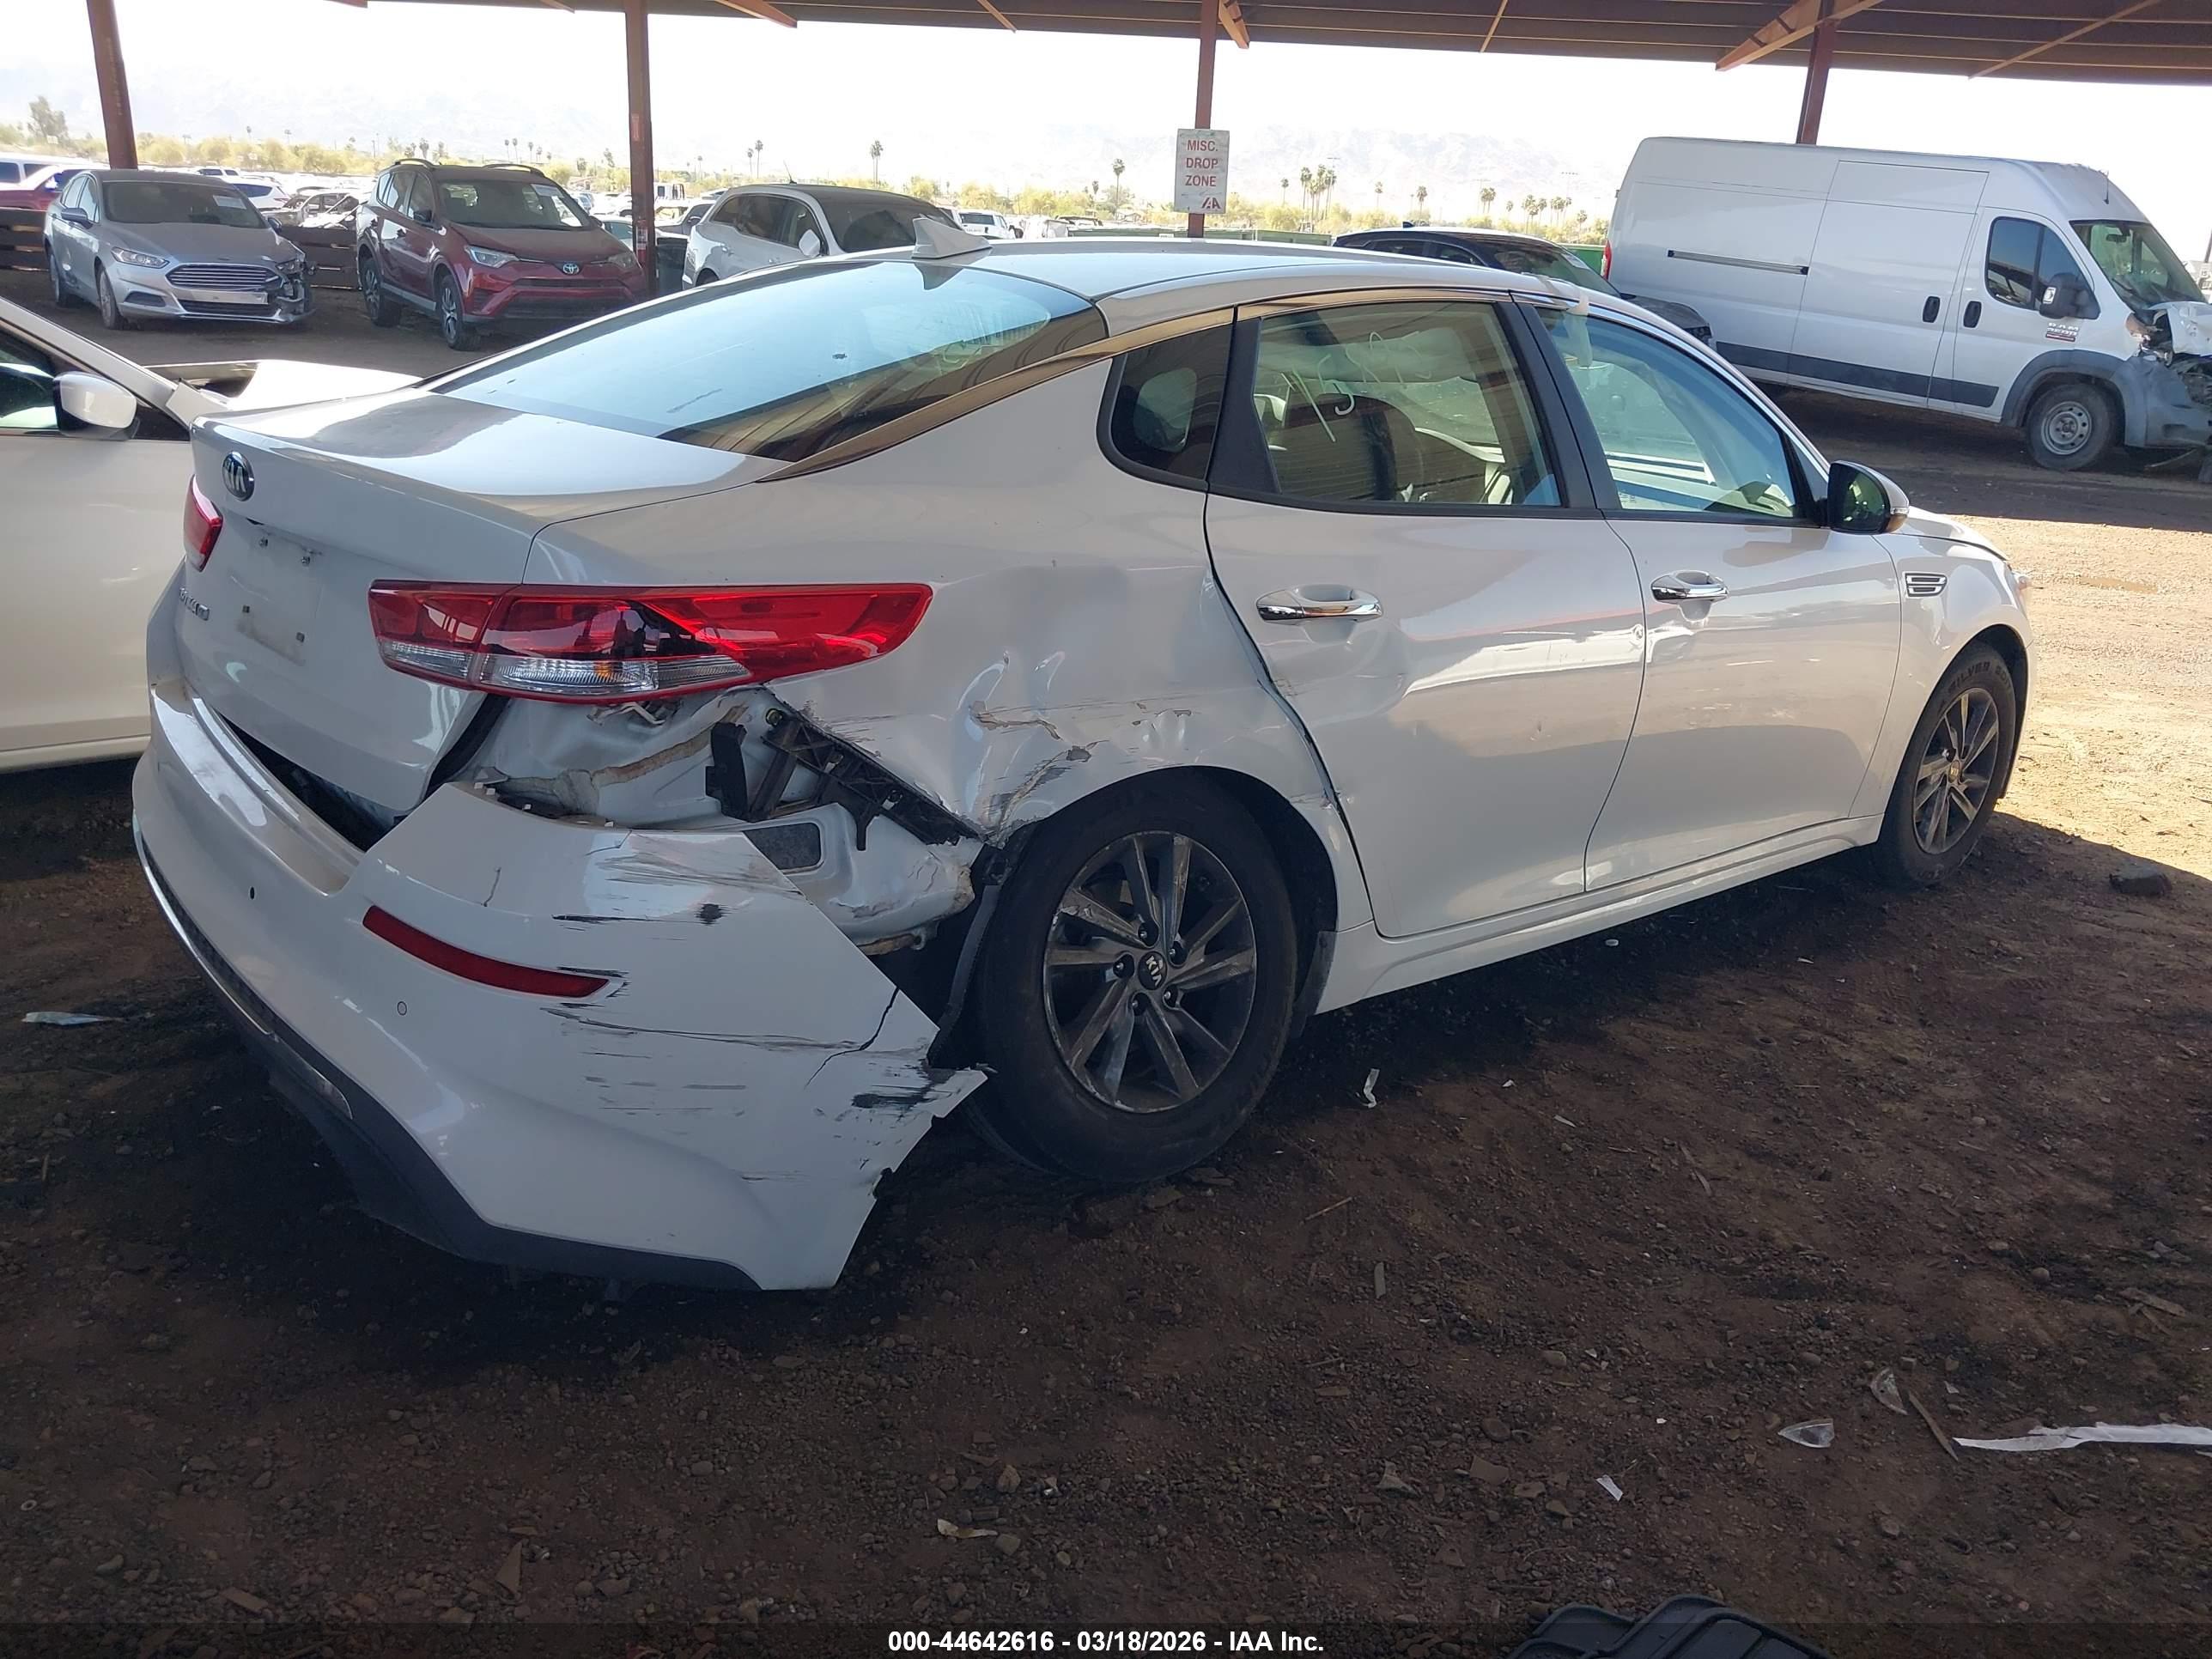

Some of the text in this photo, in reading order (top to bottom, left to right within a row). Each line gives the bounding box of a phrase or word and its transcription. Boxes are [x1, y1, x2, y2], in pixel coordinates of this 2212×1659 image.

[1187, 139, 1218, 152] MISC.
[1186, 157, 1218, 169] DROP
[1185, 174, 1217, 187] ZONE
[1146, 955, 1162, 987] KIA
